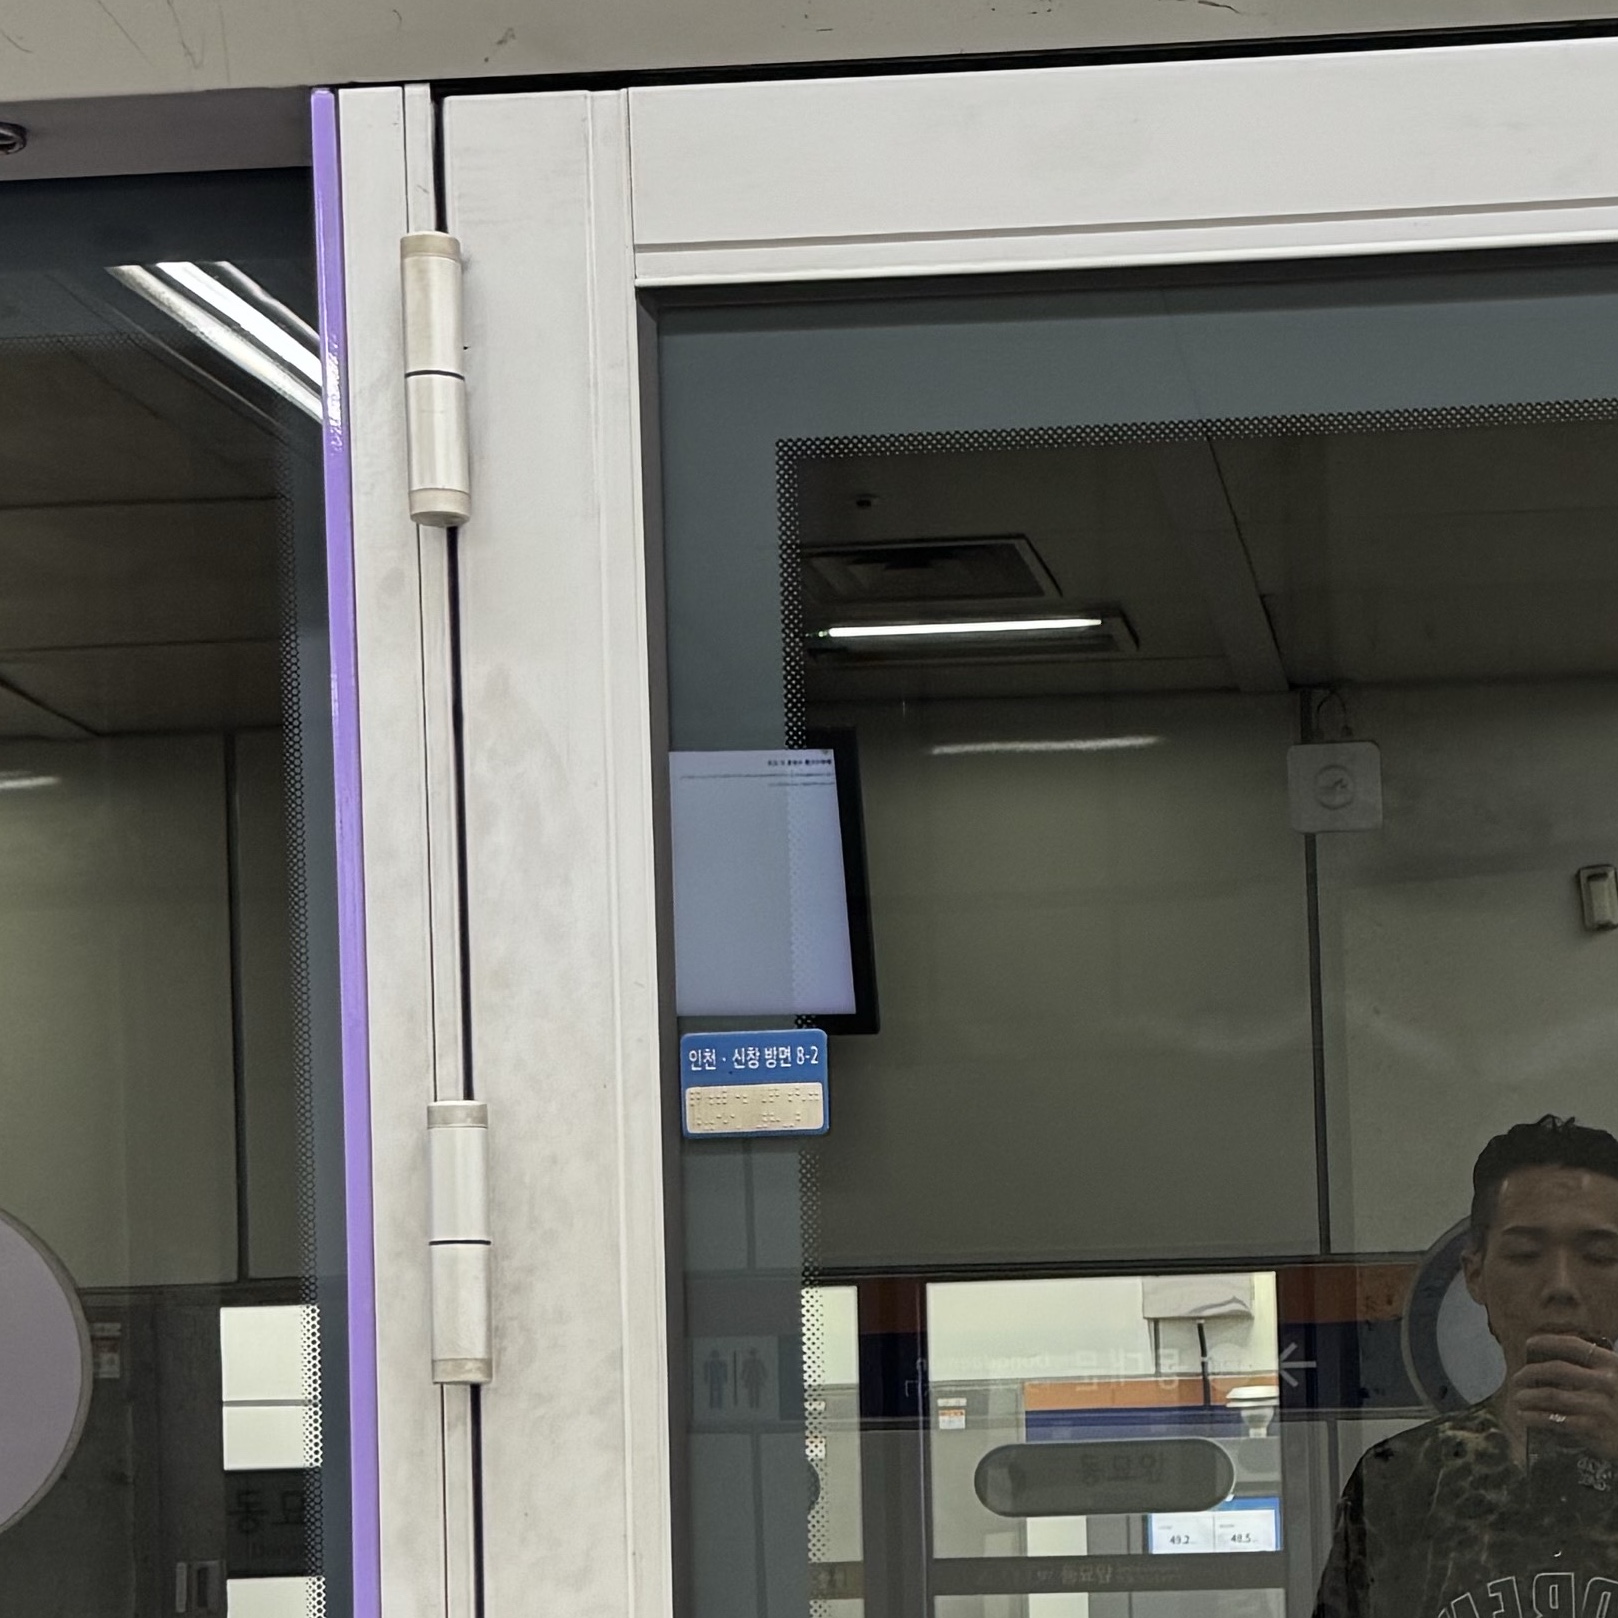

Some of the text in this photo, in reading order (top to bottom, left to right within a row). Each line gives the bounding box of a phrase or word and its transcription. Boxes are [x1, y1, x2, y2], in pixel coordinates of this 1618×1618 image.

[688, 1048, 717, 1071] 인천
[732, 1046, 760, 1070] 신창
[764, 1045, 792, 1069] 방면
[796, 1045, 819, 1065] 8-2
